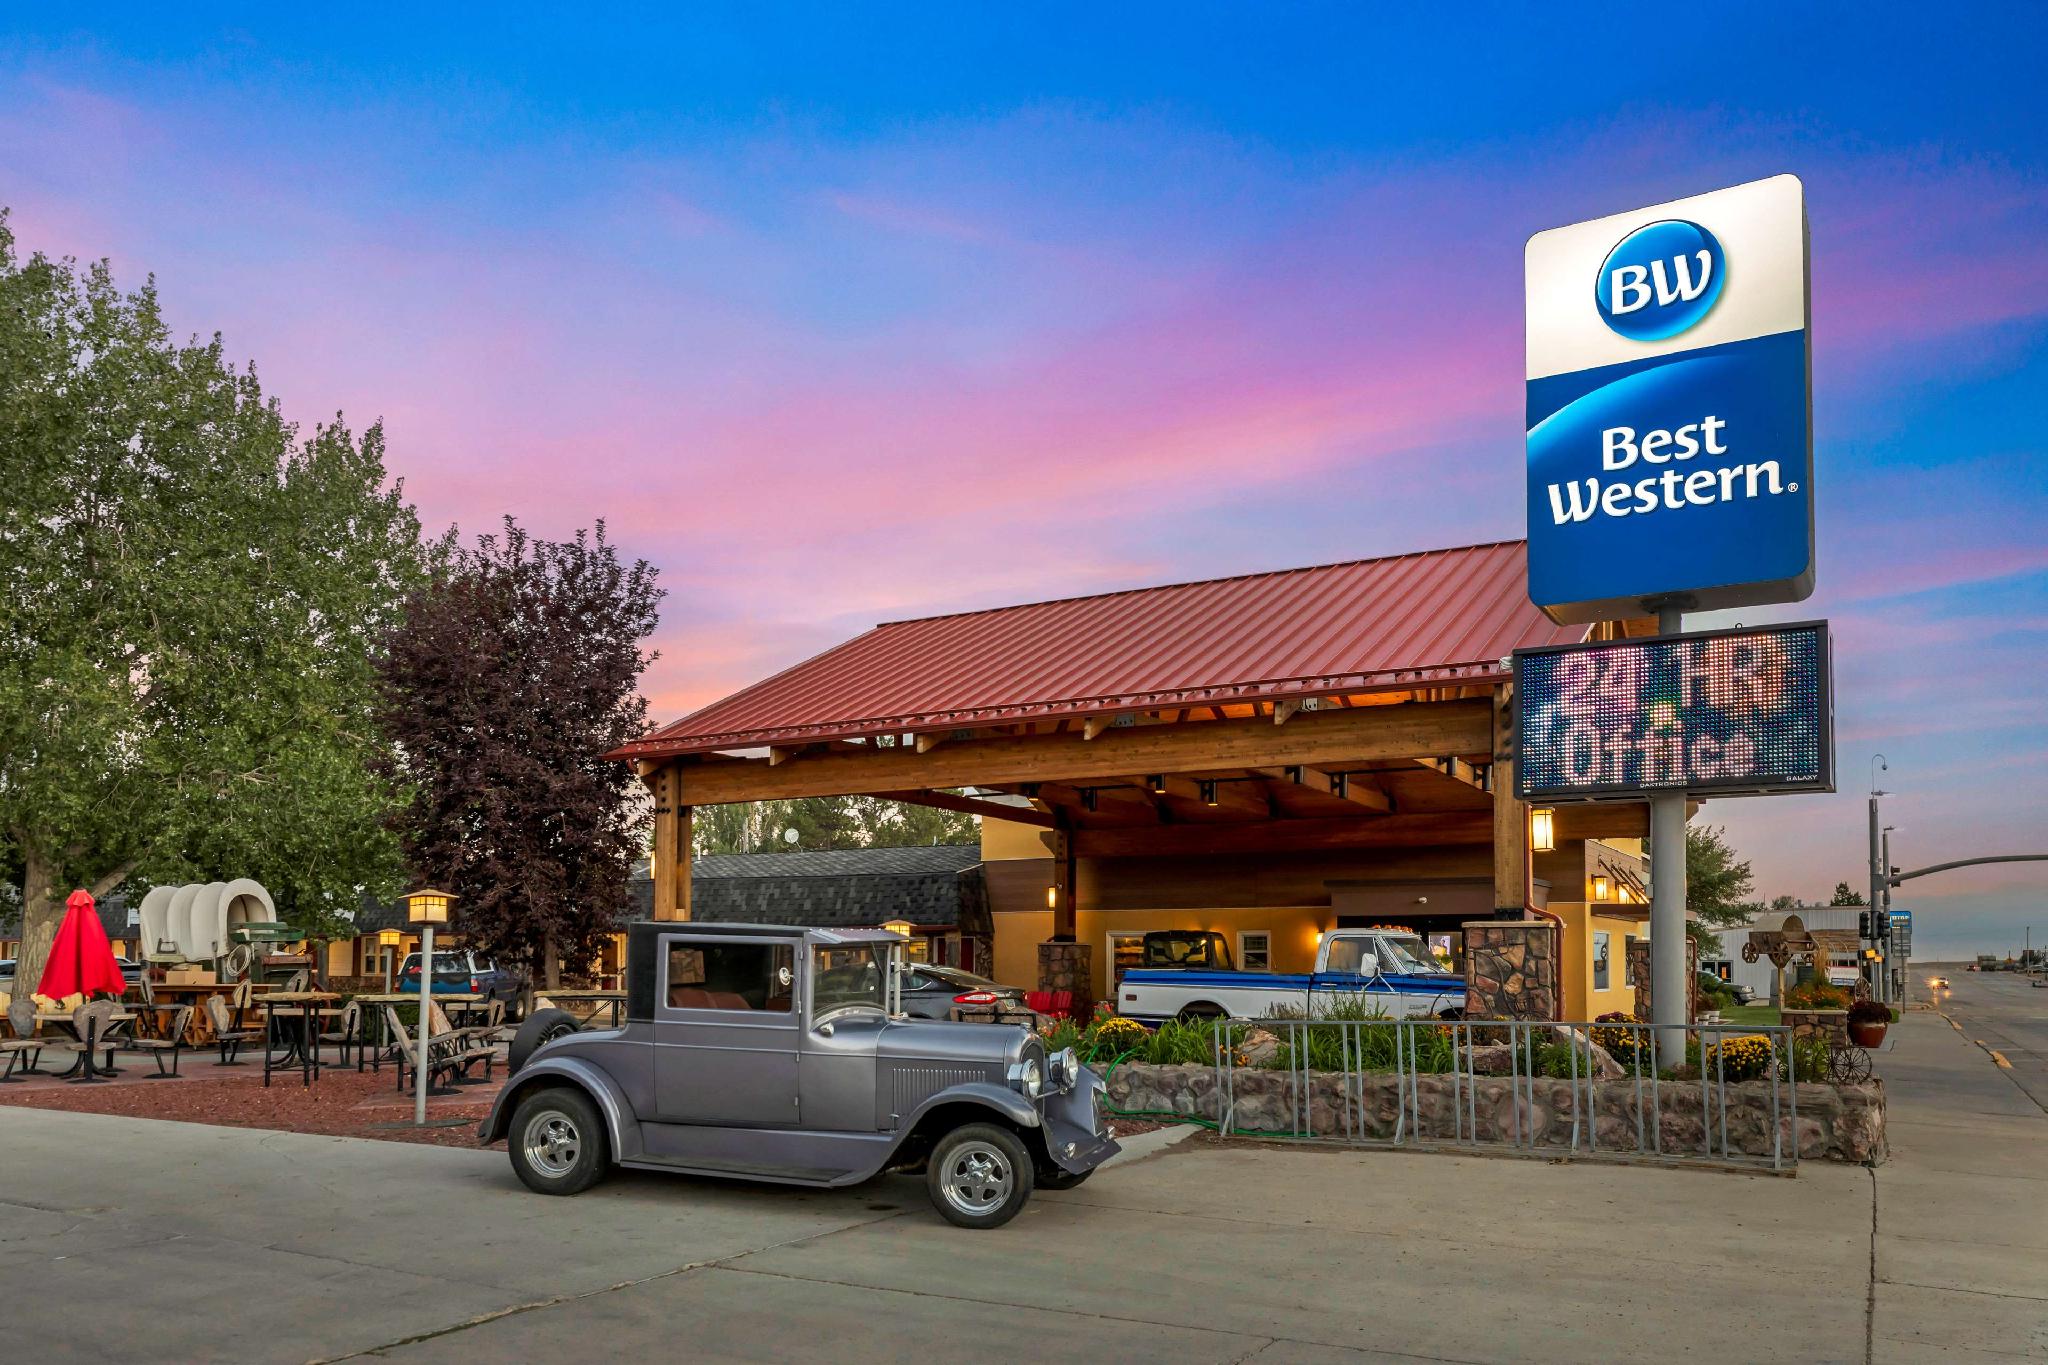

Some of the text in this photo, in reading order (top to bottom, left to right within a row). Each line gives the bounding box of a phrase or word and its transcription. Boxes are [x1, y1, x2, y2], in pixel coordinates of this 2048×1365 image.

[1611, 249, 1712, 315] BW
[1602, 415, 1727, 471] Best
[1559, 648, 1637, 716] 24
[1562, 718, 1755, 786] Office
[1786, 774, 1818, 783] GALAXY
[1639, 780, 1688, 789] DAKTRONICS
